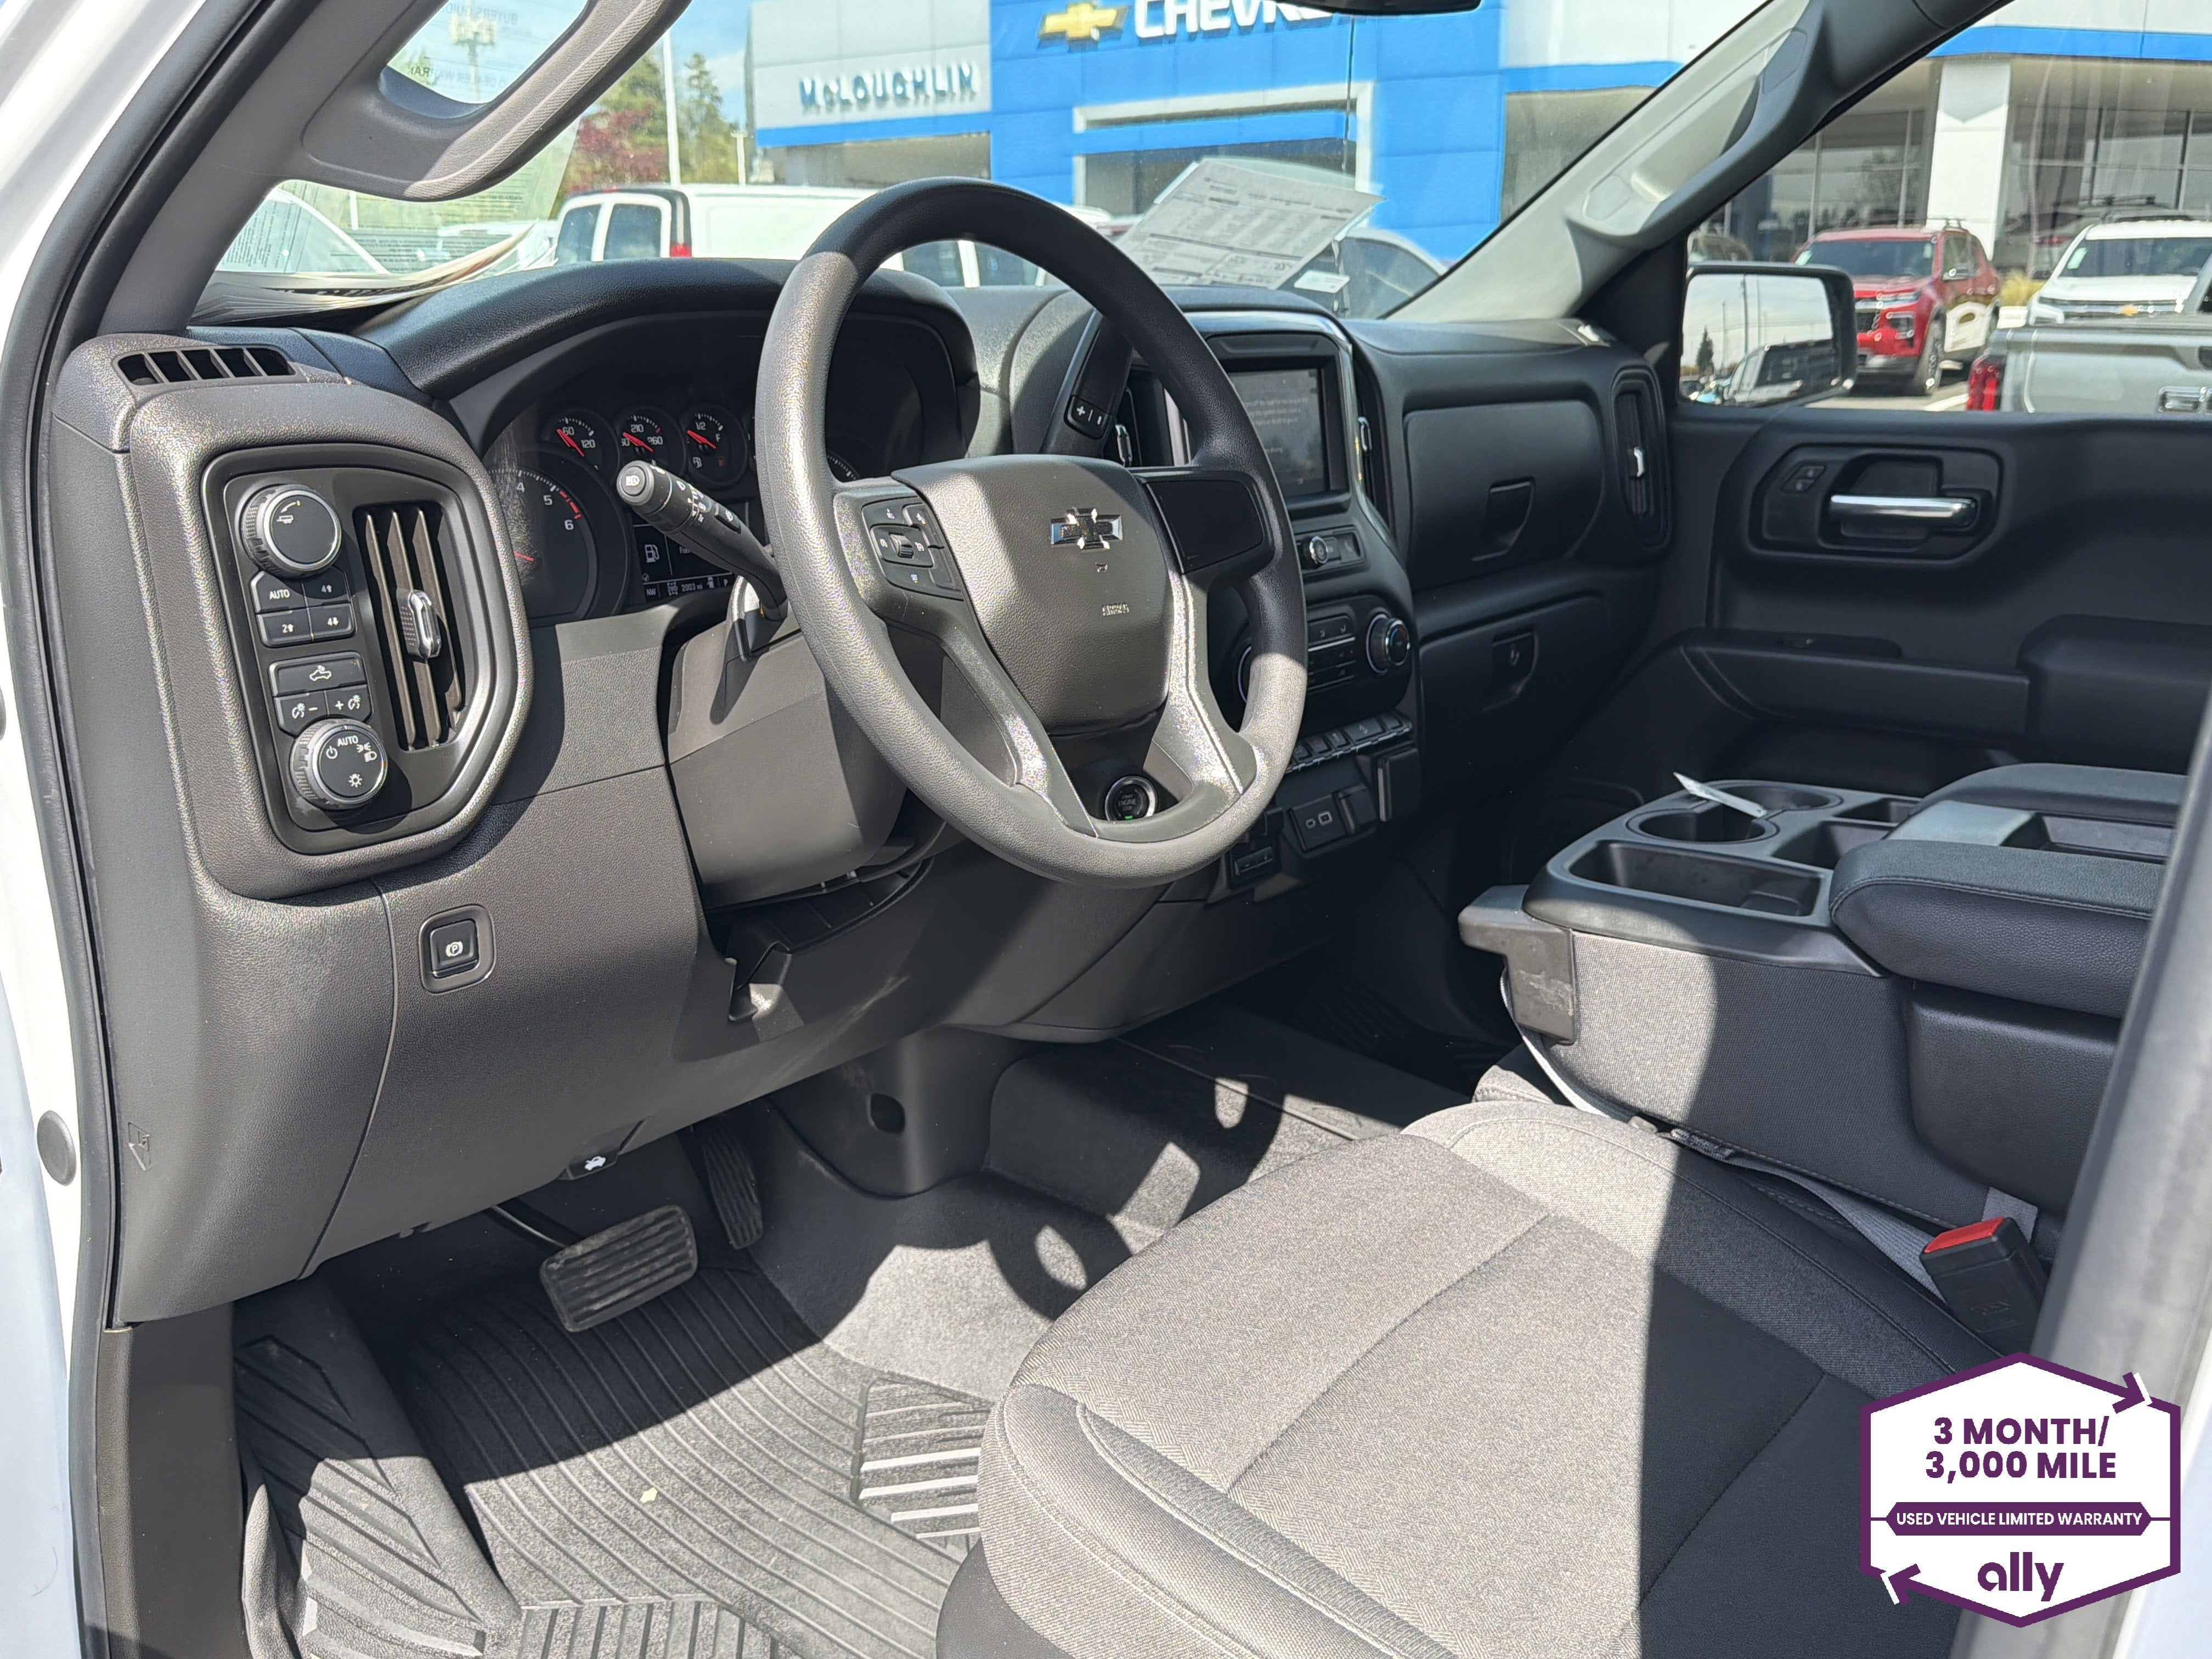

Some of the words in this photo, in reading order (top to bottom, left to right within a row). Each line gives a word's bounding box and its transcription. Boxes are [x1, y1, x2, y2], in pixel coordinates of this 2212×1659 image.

[630, 424, 645, 433] 210
[580, 438, 596, 448] 120
[516, 482, 525, 493] 4
[543, 494, 553, 506] 5
[564, 519, 574, 531] 6
[269, 589, 291, 600] AUTO
[337, 735, 359, 747] AUTO
